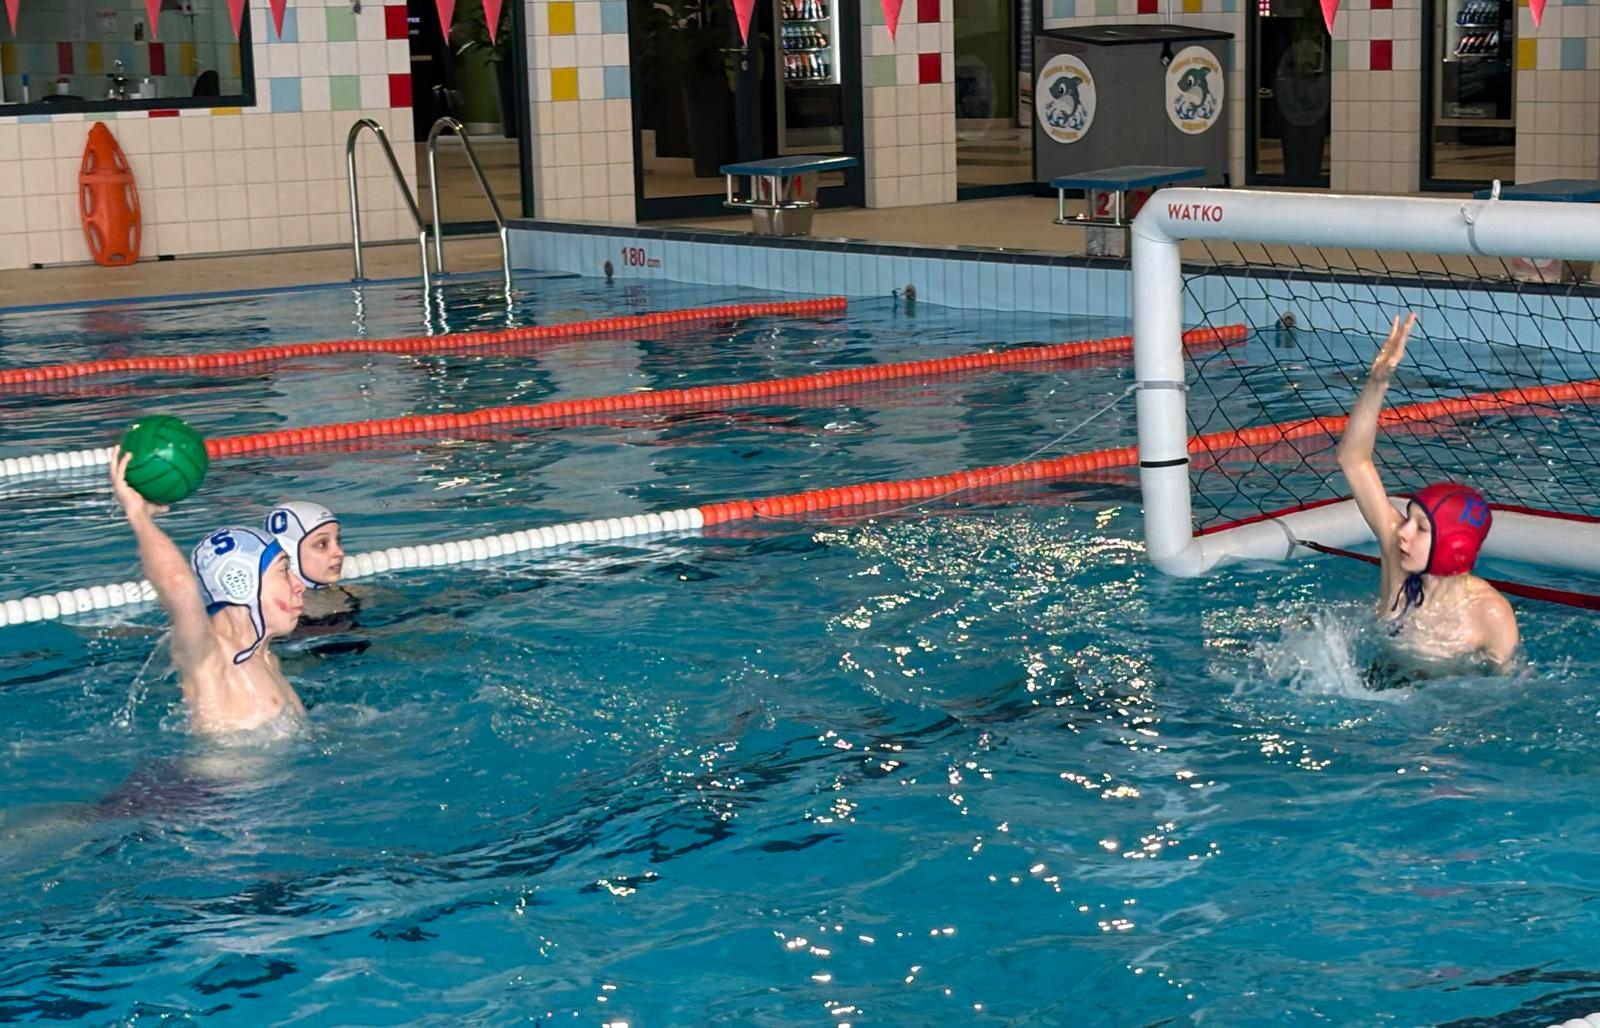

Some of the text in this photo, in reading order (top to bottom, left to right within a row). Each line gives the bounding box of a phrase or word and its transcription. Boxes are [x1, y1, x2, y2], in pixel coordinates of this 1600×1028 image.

[1096, 191, 1110, 216] 2
[1168, 203, 1223, 222] WATKO
[622, 246, 646, 267] 180
[1460, 496, 1489, 529] 13
